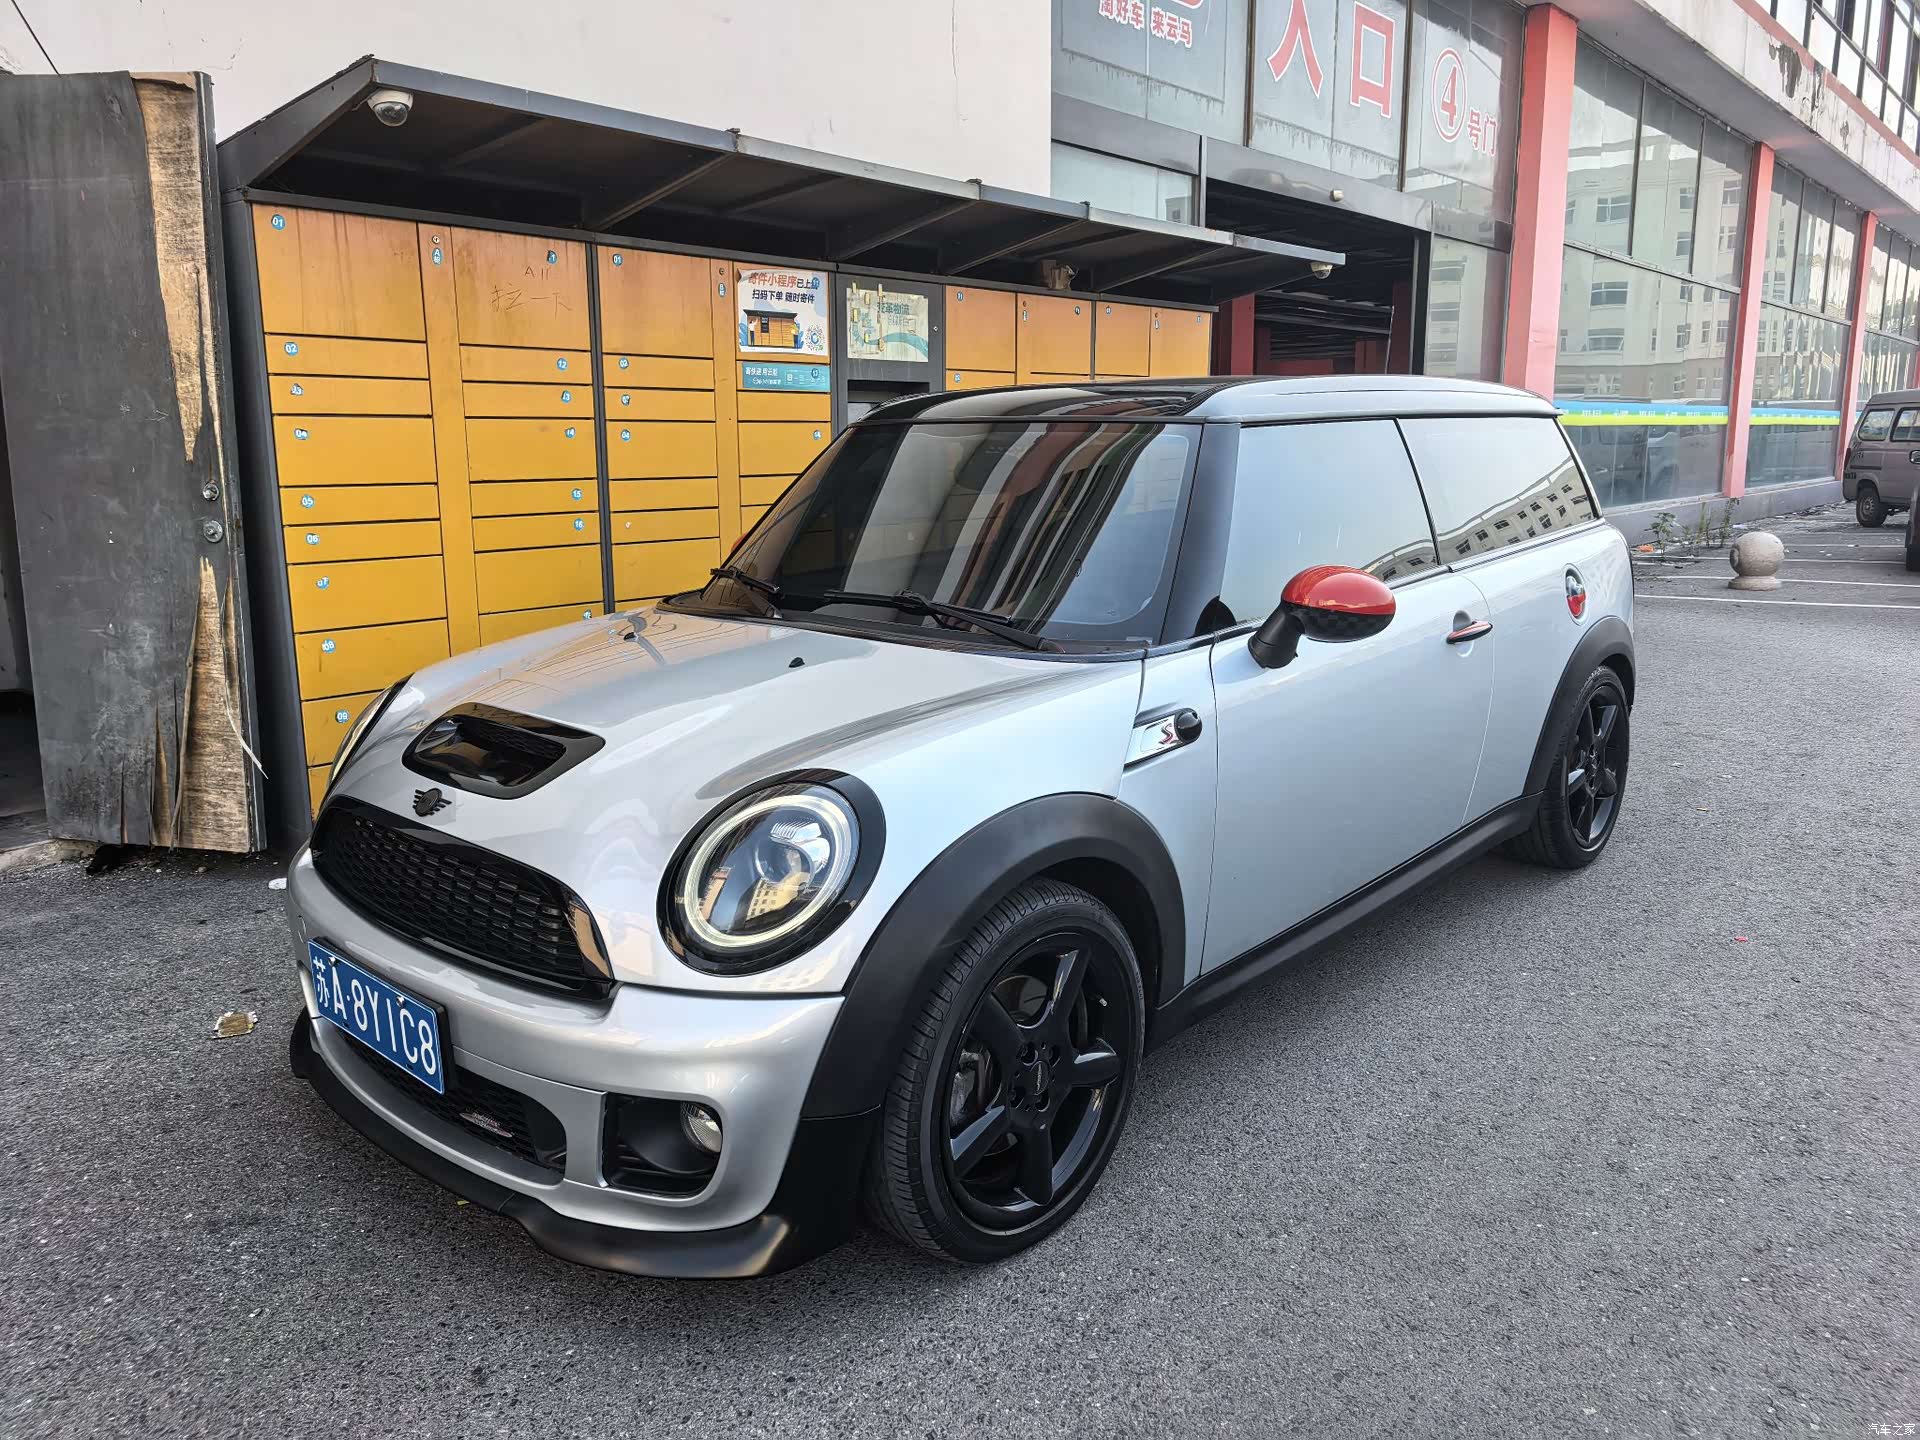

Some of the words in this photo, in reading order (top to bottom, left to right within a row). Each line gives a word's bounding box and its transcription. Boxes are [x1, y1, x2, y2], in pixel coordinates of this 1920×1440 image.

[1151, 6, 1192, 48] 来云马
[272, 216, 283, 228] 01
[752, 289, 784, 302] 扫码下单
[285, 343, 298, 353] 02
